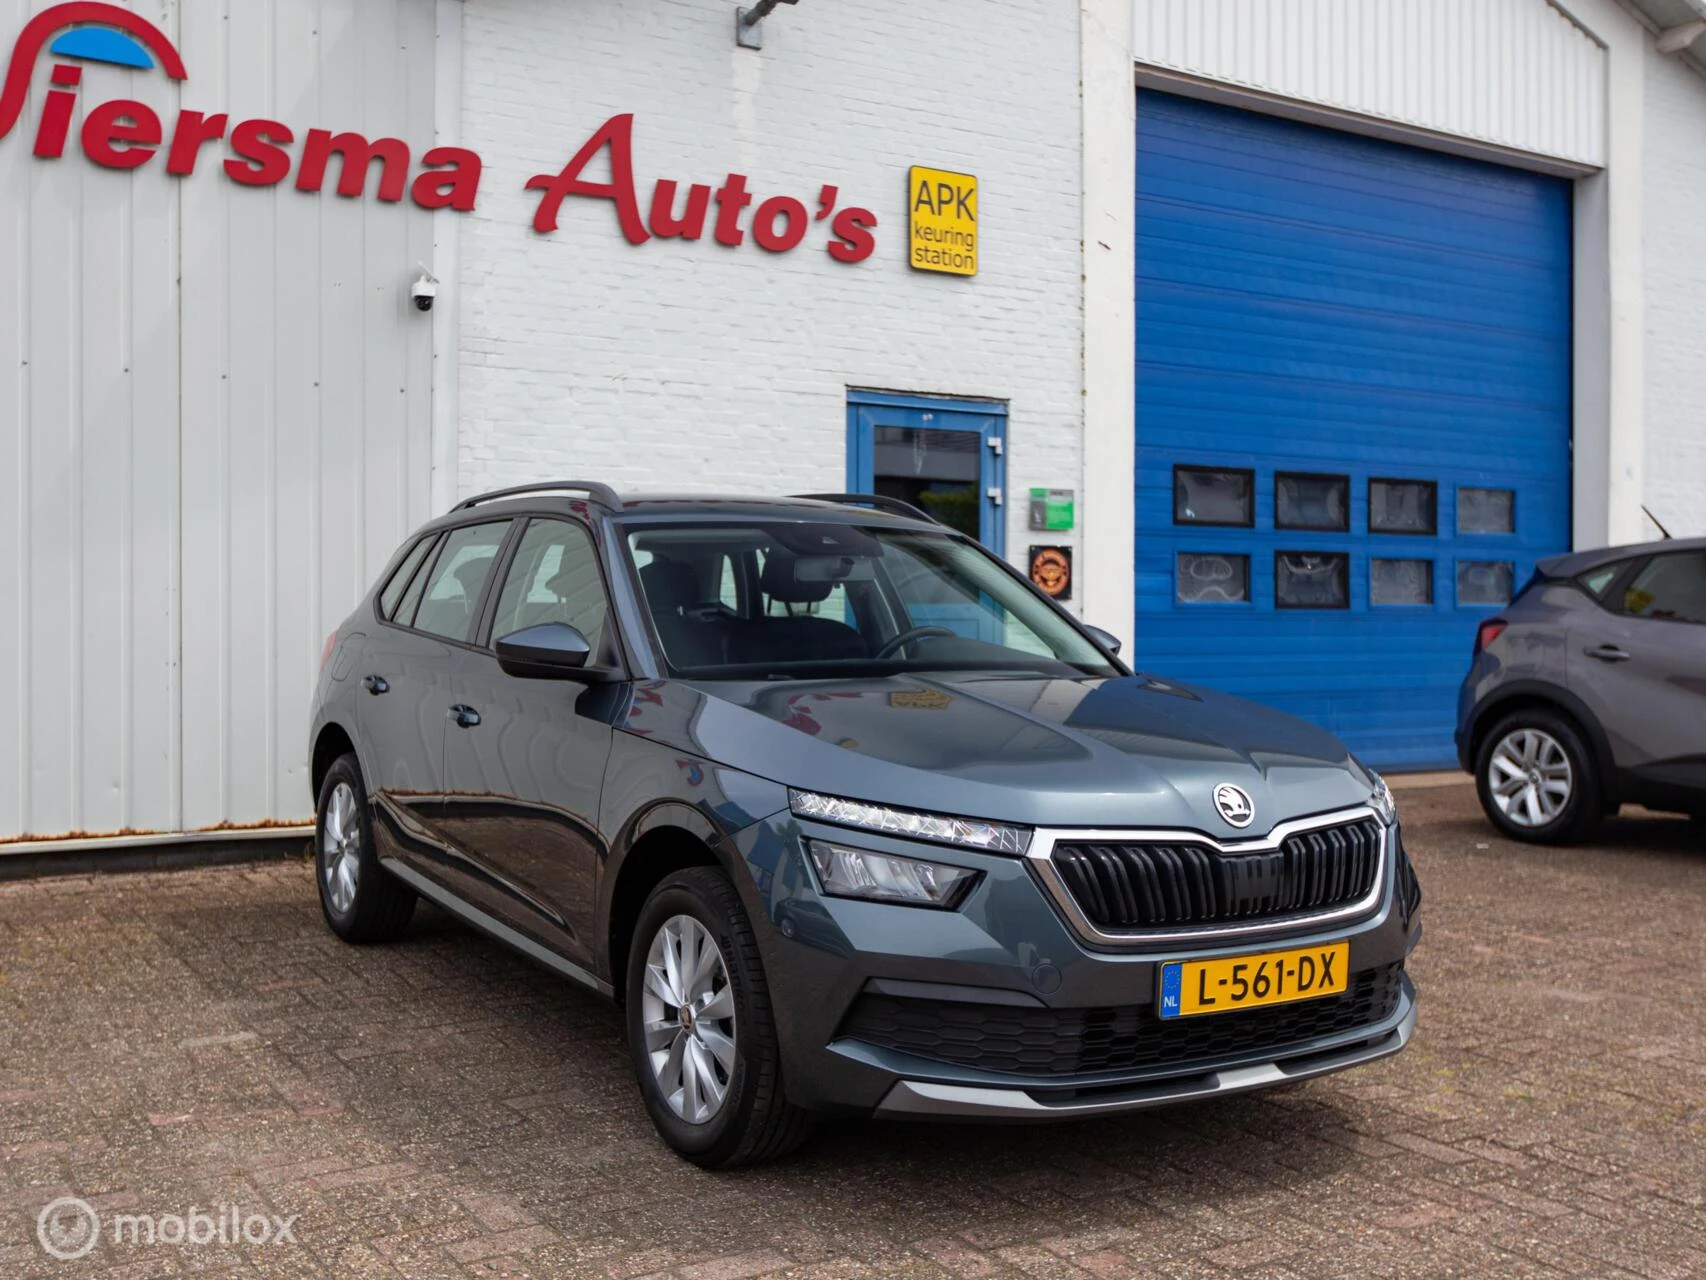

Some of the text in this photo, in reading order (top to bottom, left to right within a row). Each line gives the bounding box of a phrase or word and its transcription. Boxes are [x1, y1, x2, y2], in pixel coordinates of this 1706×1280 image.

[525, 113, 878, 262] Auto's
[913, 180, 976, 222] APK
[914, 221, 975, 252] keuring
[914, 246, 975, 270] station
[1198, 951, 1336, 1006] L-561-DX
[1163, 996, 1178, 1008] NL
